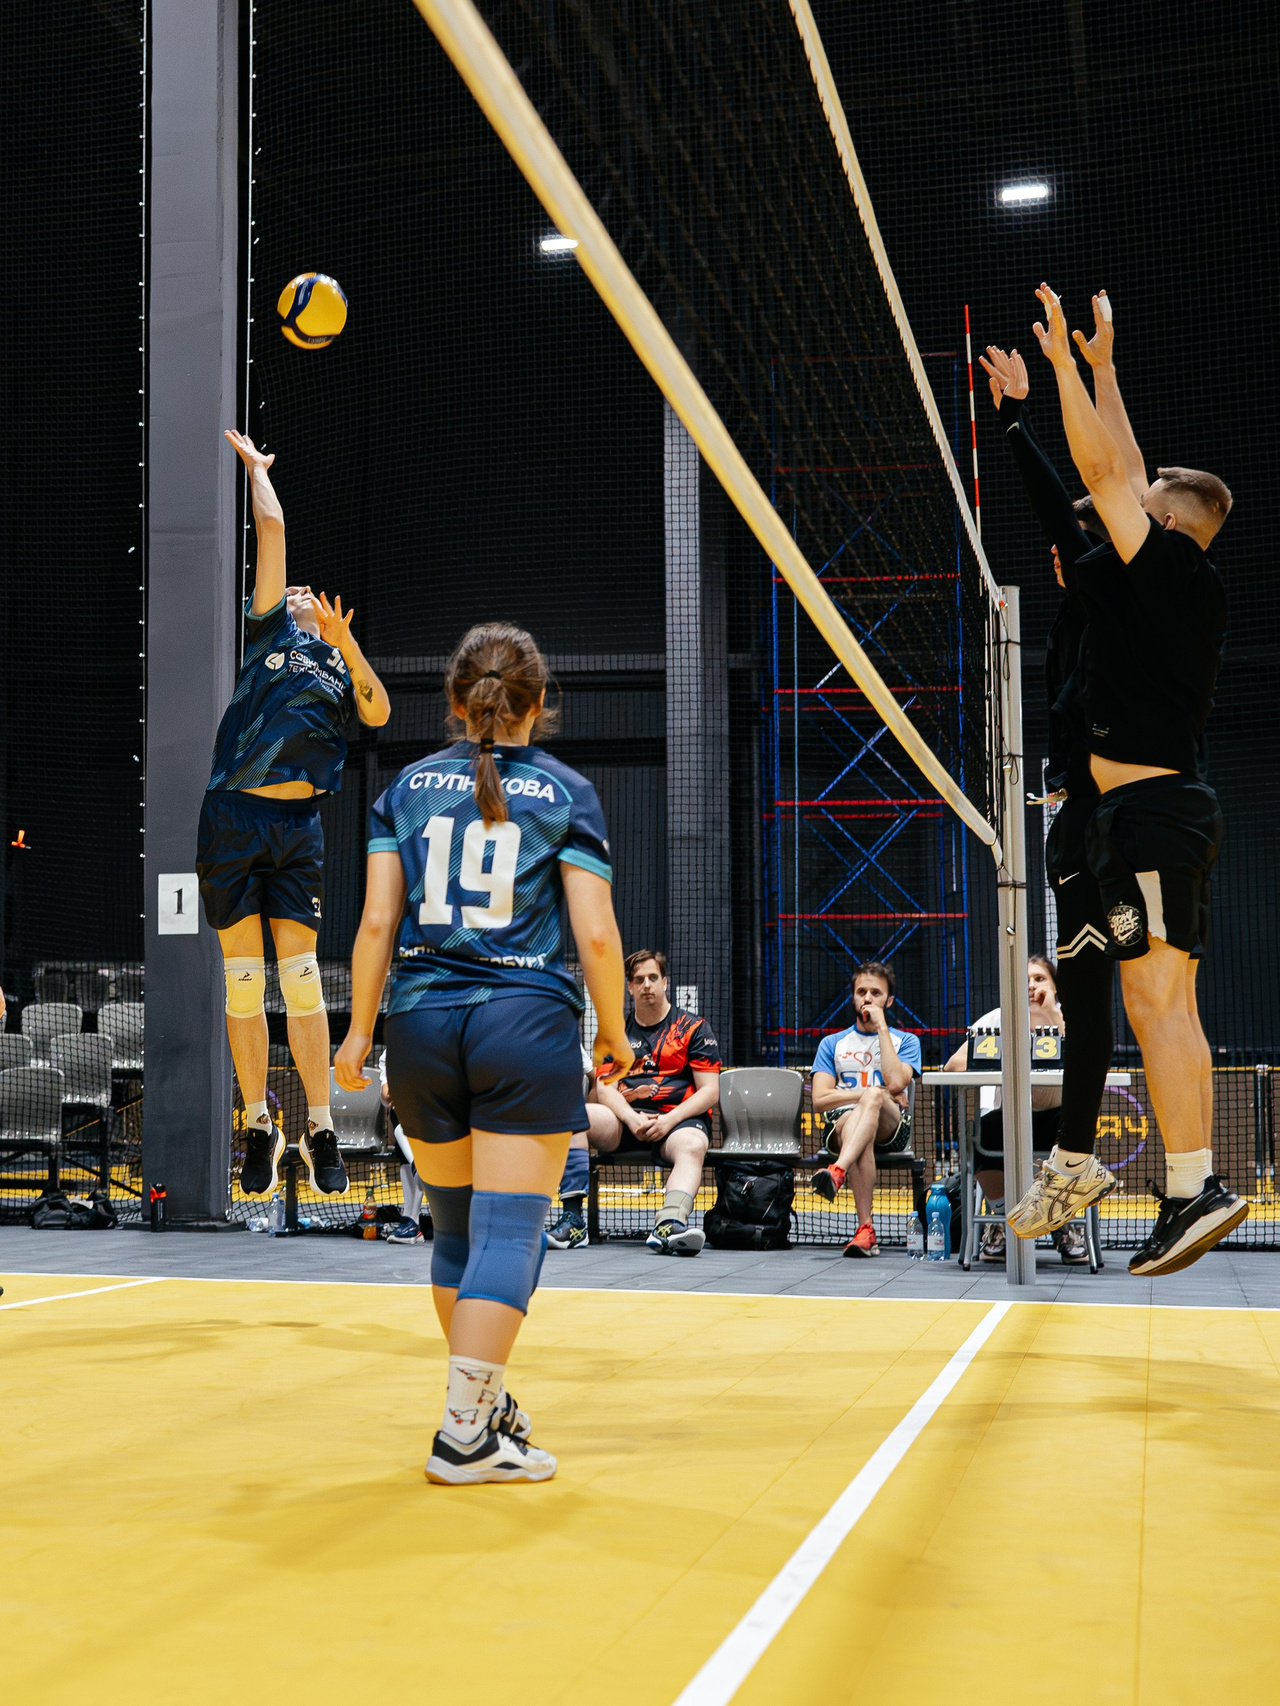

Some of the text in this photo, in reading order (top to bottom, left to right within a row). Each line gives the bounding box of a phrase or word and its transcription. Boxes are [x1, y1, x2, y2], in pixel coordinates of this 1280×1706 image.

[409, 771, 555, 803] СТУПНОВА
[418, 815, 521, 929] 19
[173, 887, 186, 916] 1
[976, 1036, 1058, 1058] 4 3
